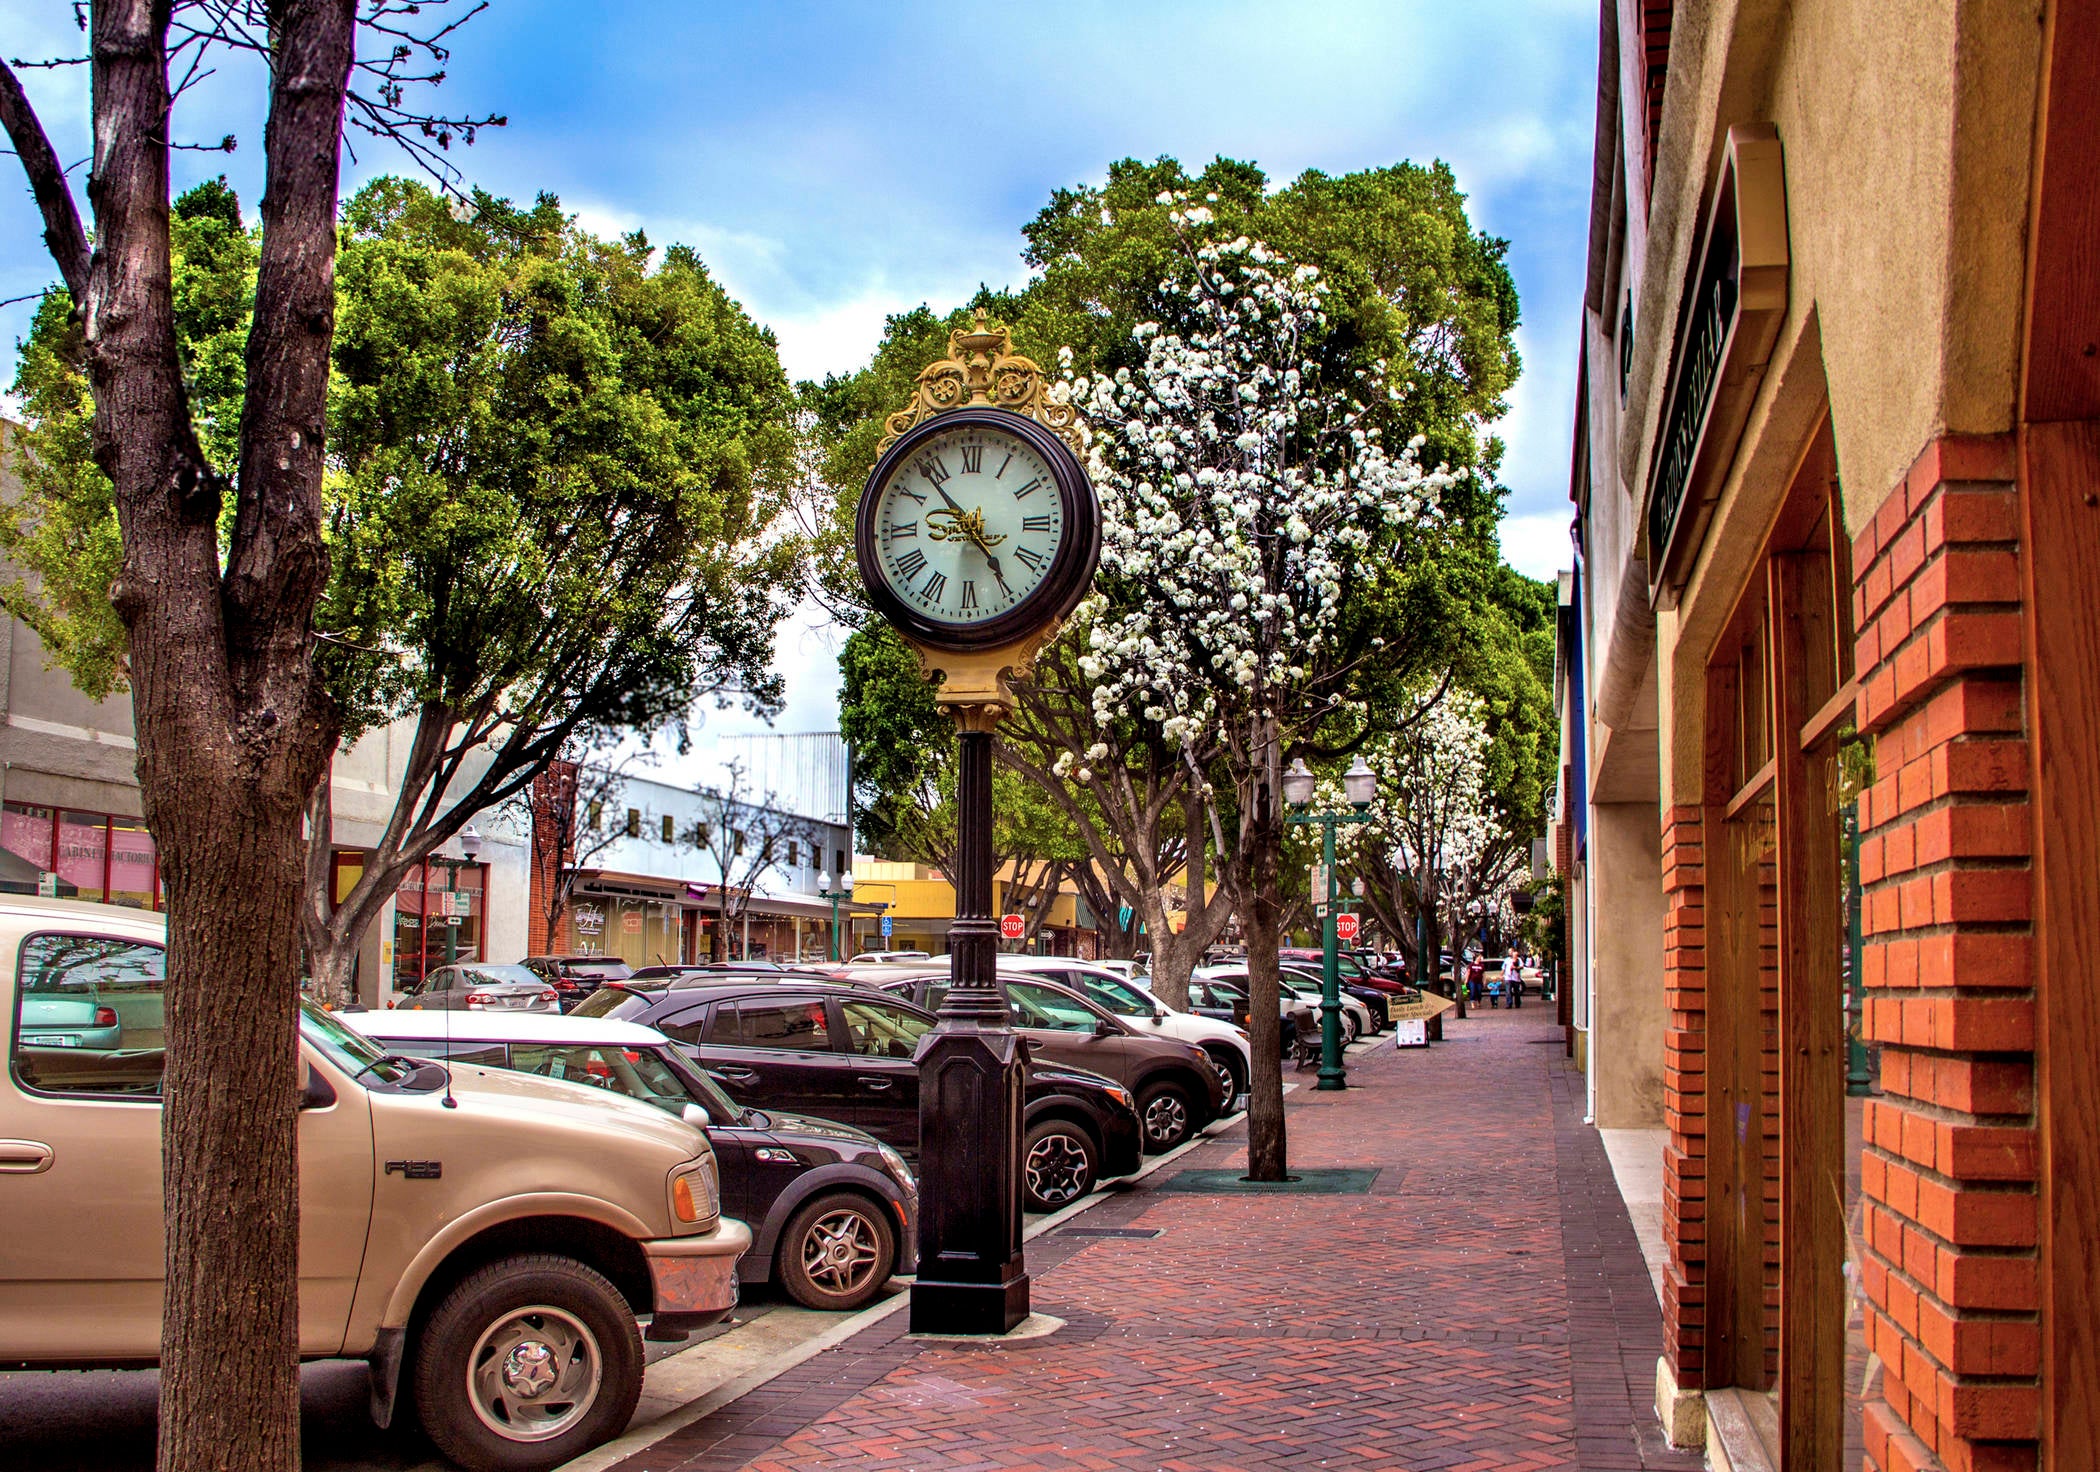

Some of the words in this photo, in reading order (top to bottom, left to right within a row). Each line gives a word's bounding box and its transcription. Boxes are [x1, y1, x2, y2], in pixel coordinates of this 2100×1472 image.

[925, 455, 951, 485] XI
[960, 445, 984, 474] XII
[995, 453, 1013, 480] I
[901, 485, 928, 506] X
[1013, 477, 1042, 501] II
[890, 520, 918, 540] IX
[1022, 514, 1051, 533] III
[895, 547, 928, 584] VIII
[1013, 545, 1044, 574] IV
[919, 570, 948, 604] VII
[960, 580, 979, 609] VI
[994, 572, 1014, 599] V
[1003, 921, 1023, 931] STOP
[1337, 921, 1357, 932] STOP
